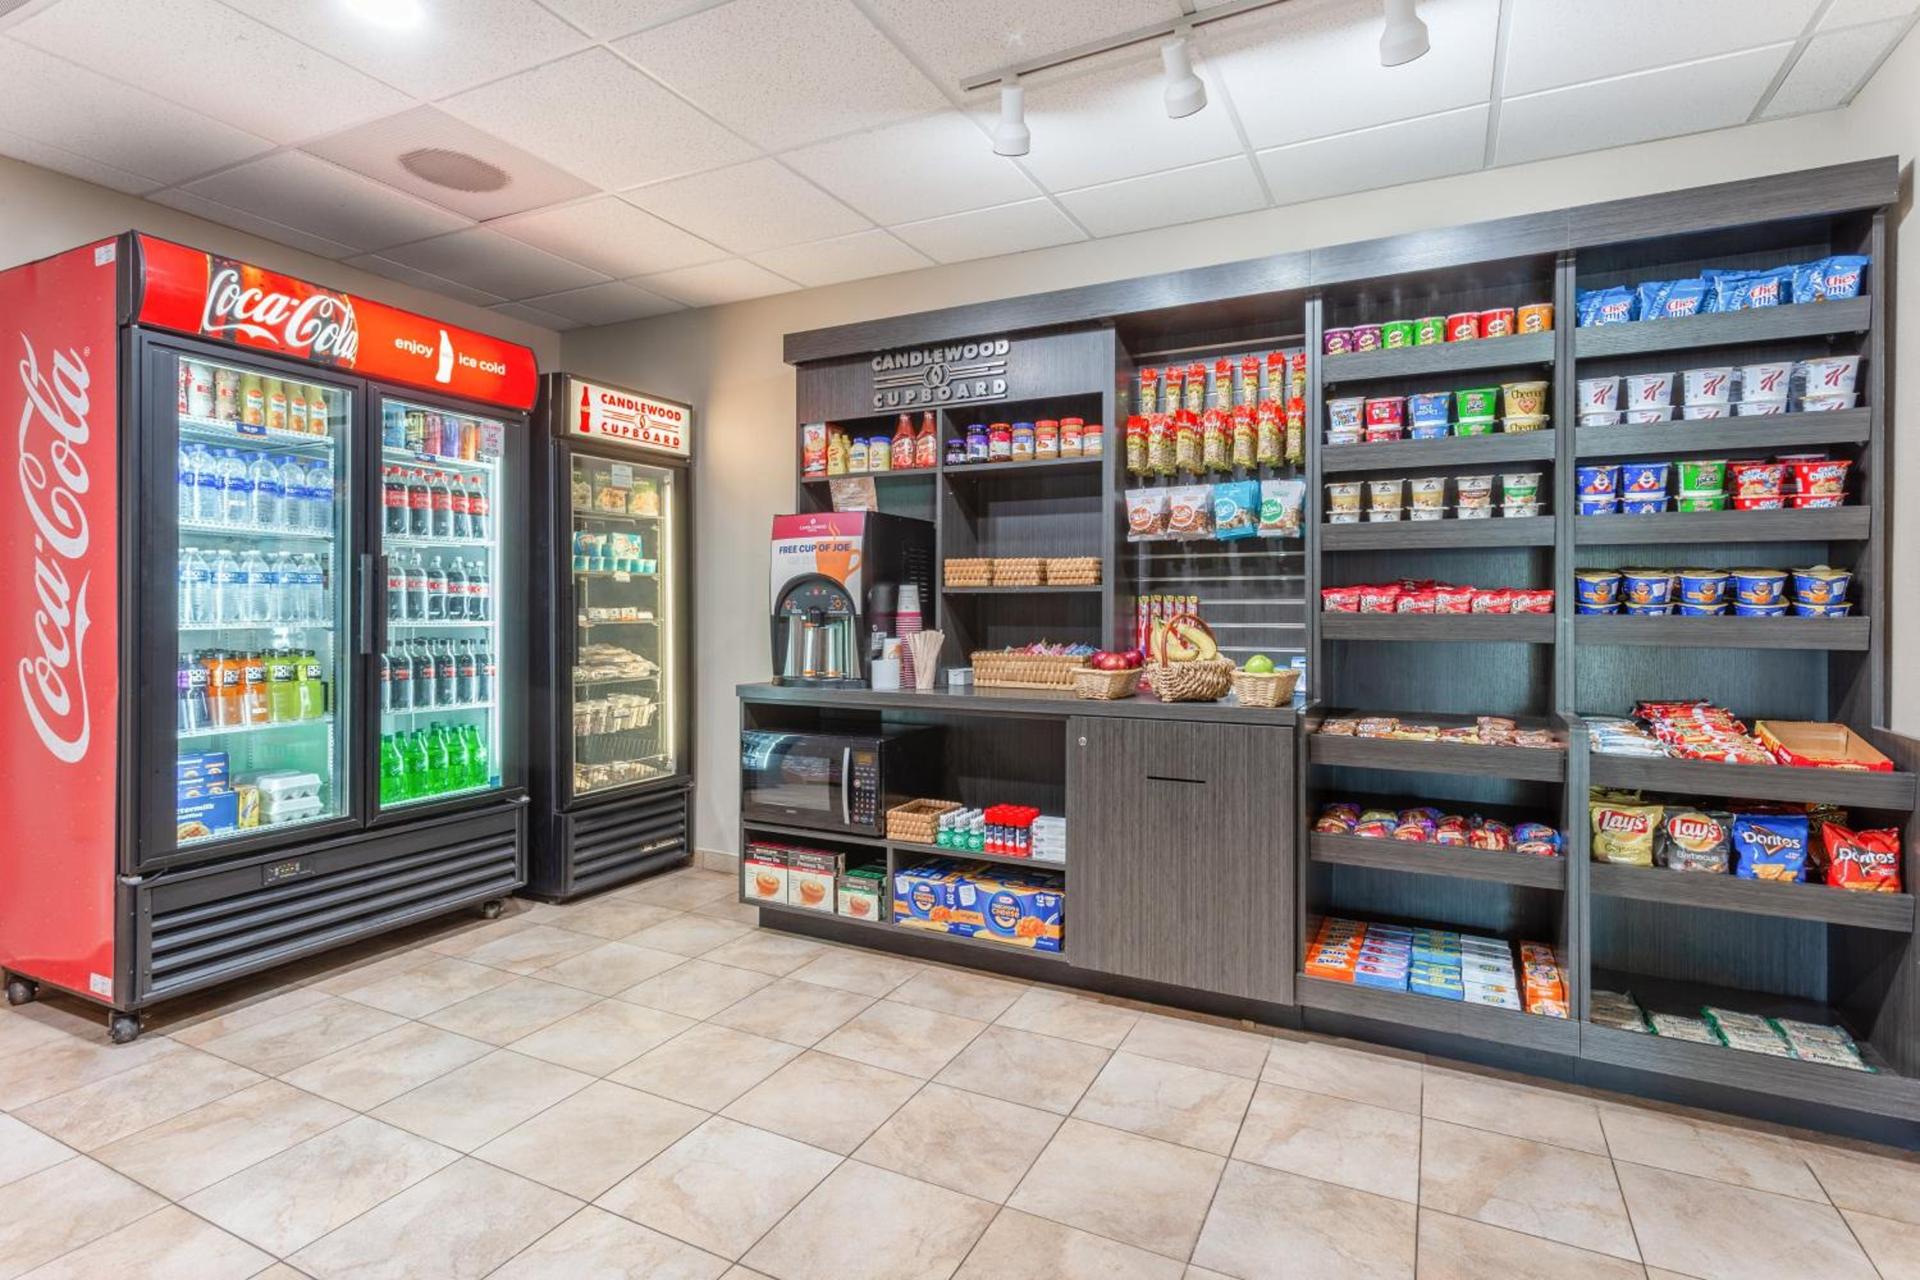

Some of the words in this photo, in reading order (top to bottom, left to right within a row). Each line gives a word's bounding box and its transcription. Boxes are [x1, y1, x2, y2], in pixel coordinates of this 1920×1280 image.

[1824, 274, 1857, 288] Chex
[1826, 284, 1854, 297] mix
[202, 269, 358, 361] Coca-Cola
[1601, 301, 1631, 314] Chex
[1667, 297, 1698, 311] Chex
[395, 338, 434, 358] enjoy
[459, 354, 477, 369] ice
[479, 359, 506, 376] cold
[871, 340, 1010, 371] CANDLEWOOD
[873, 380, 1007, 407] CUPBOARD
[601, 393, 682, 421] CANDLEWOOD
[601, 422, 680, 446] CUPBOARD
[18, 329, 91, 763] Coca-Cola
[779, 545, 797, 554] FREE
[799, 544, 817, 553] CUP
[819, 544, 831, 552] OF
[833, 544, 851, 552] JOE
[1601, 811, 1647, 833] Lay's
[1673, 819, 1719, 841] Lay's
[1743, 831, 1801, 849] Doritos
[1838, 848, 1896, 864] Doritos
